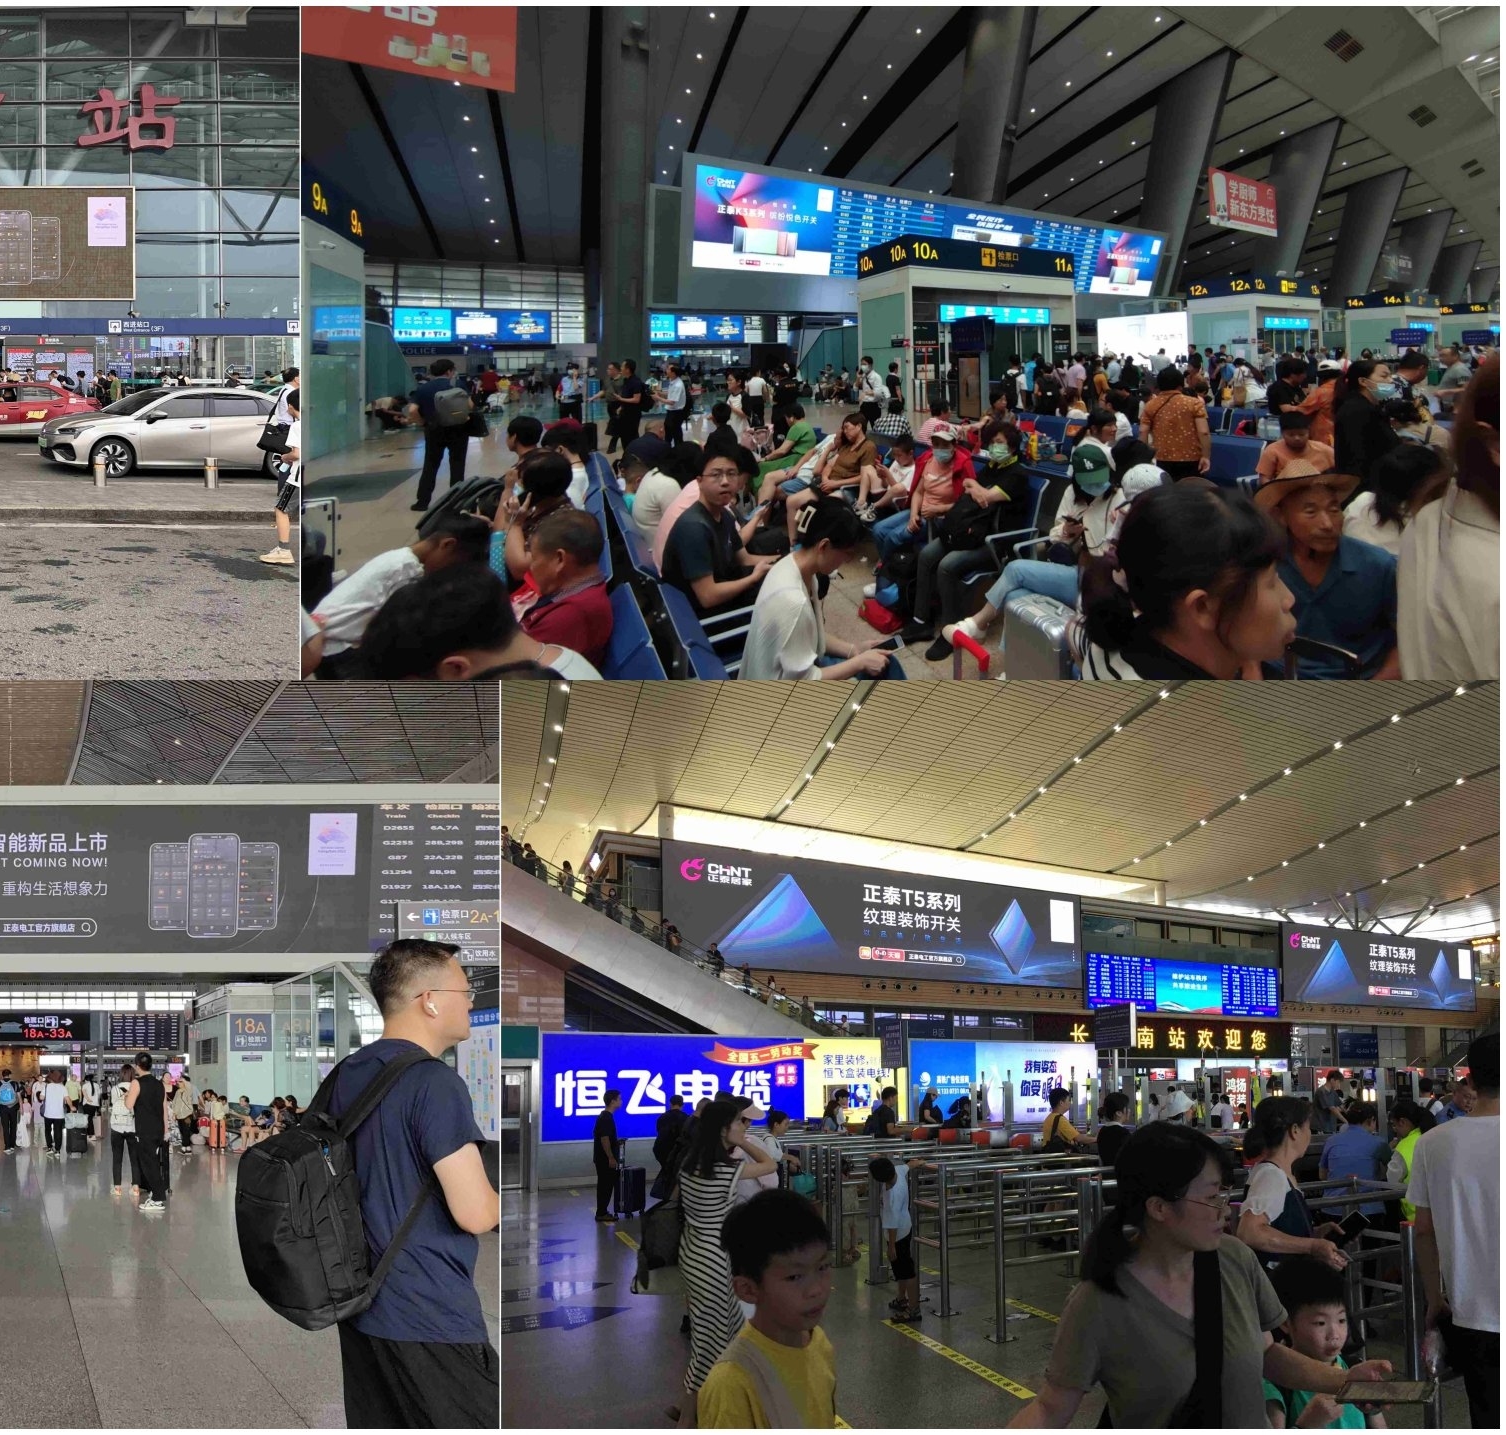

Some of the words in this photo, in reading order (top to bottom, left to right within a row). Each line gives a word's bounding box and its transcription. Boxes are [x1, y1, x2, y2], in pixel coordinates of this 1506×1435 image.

[1229, 180, 1257, 202] 学厨师
[312, 183, 328, 216] 9A
[769, 211, 818, 225] 缤纷悦色开关
[1230, 199, 1275, 224] 新东方烹饪
[351, 209, 362, 237] 9A
[890, 245, 906, 262] 10A
[912, 241, 938, 260] 10A
[997, 250, 1019, 261] 检票口
[860, 256, 873, 272] 10A
[1054, 257, 1073, 273] 11A
[1189, 285, 1208, 296] 12A
[1230, 280, 1251, 291] 12A
[1347, 298, 1364, 307] 14A
[1383, 295, 1401, 304] 14A
[151, 325, 164, 333] (3F)
[13, 857, 67, 868] COMING
[72, 857, 108, 868] NOW!
[708, 874, 753, 886] 正泰居家
[2, 881, 108, 897] 重构生活想象力
[862, 883, 961, 912] 正泰T5系列
[441, 909, 469, 919] 检票口
[863, 907, 961, 933] 纹理装饰开关
[3, 923, 75, 933] 正泰电工官方旗舰店
[1369, 943, 1416, 961] 正泰T5系列
[1369, 959, 1416, 975] 纹理装饰开关
[24, 1016, 44, 1024] 检票口
[235, 1018, 266, 1034] 18A
[24, 1028, 72, 1039] 18A-33A
[247, 1035, 267, 1043] 检票口
[726, 1045, 803, 1063] 全国五一劳动奖
[1024, 1060, 1057, 1073] 我有姿态
[555, 1069, 772, 1117] 恒飞电缆
[1225, 1078, 1247, 1093] 鸿扬
